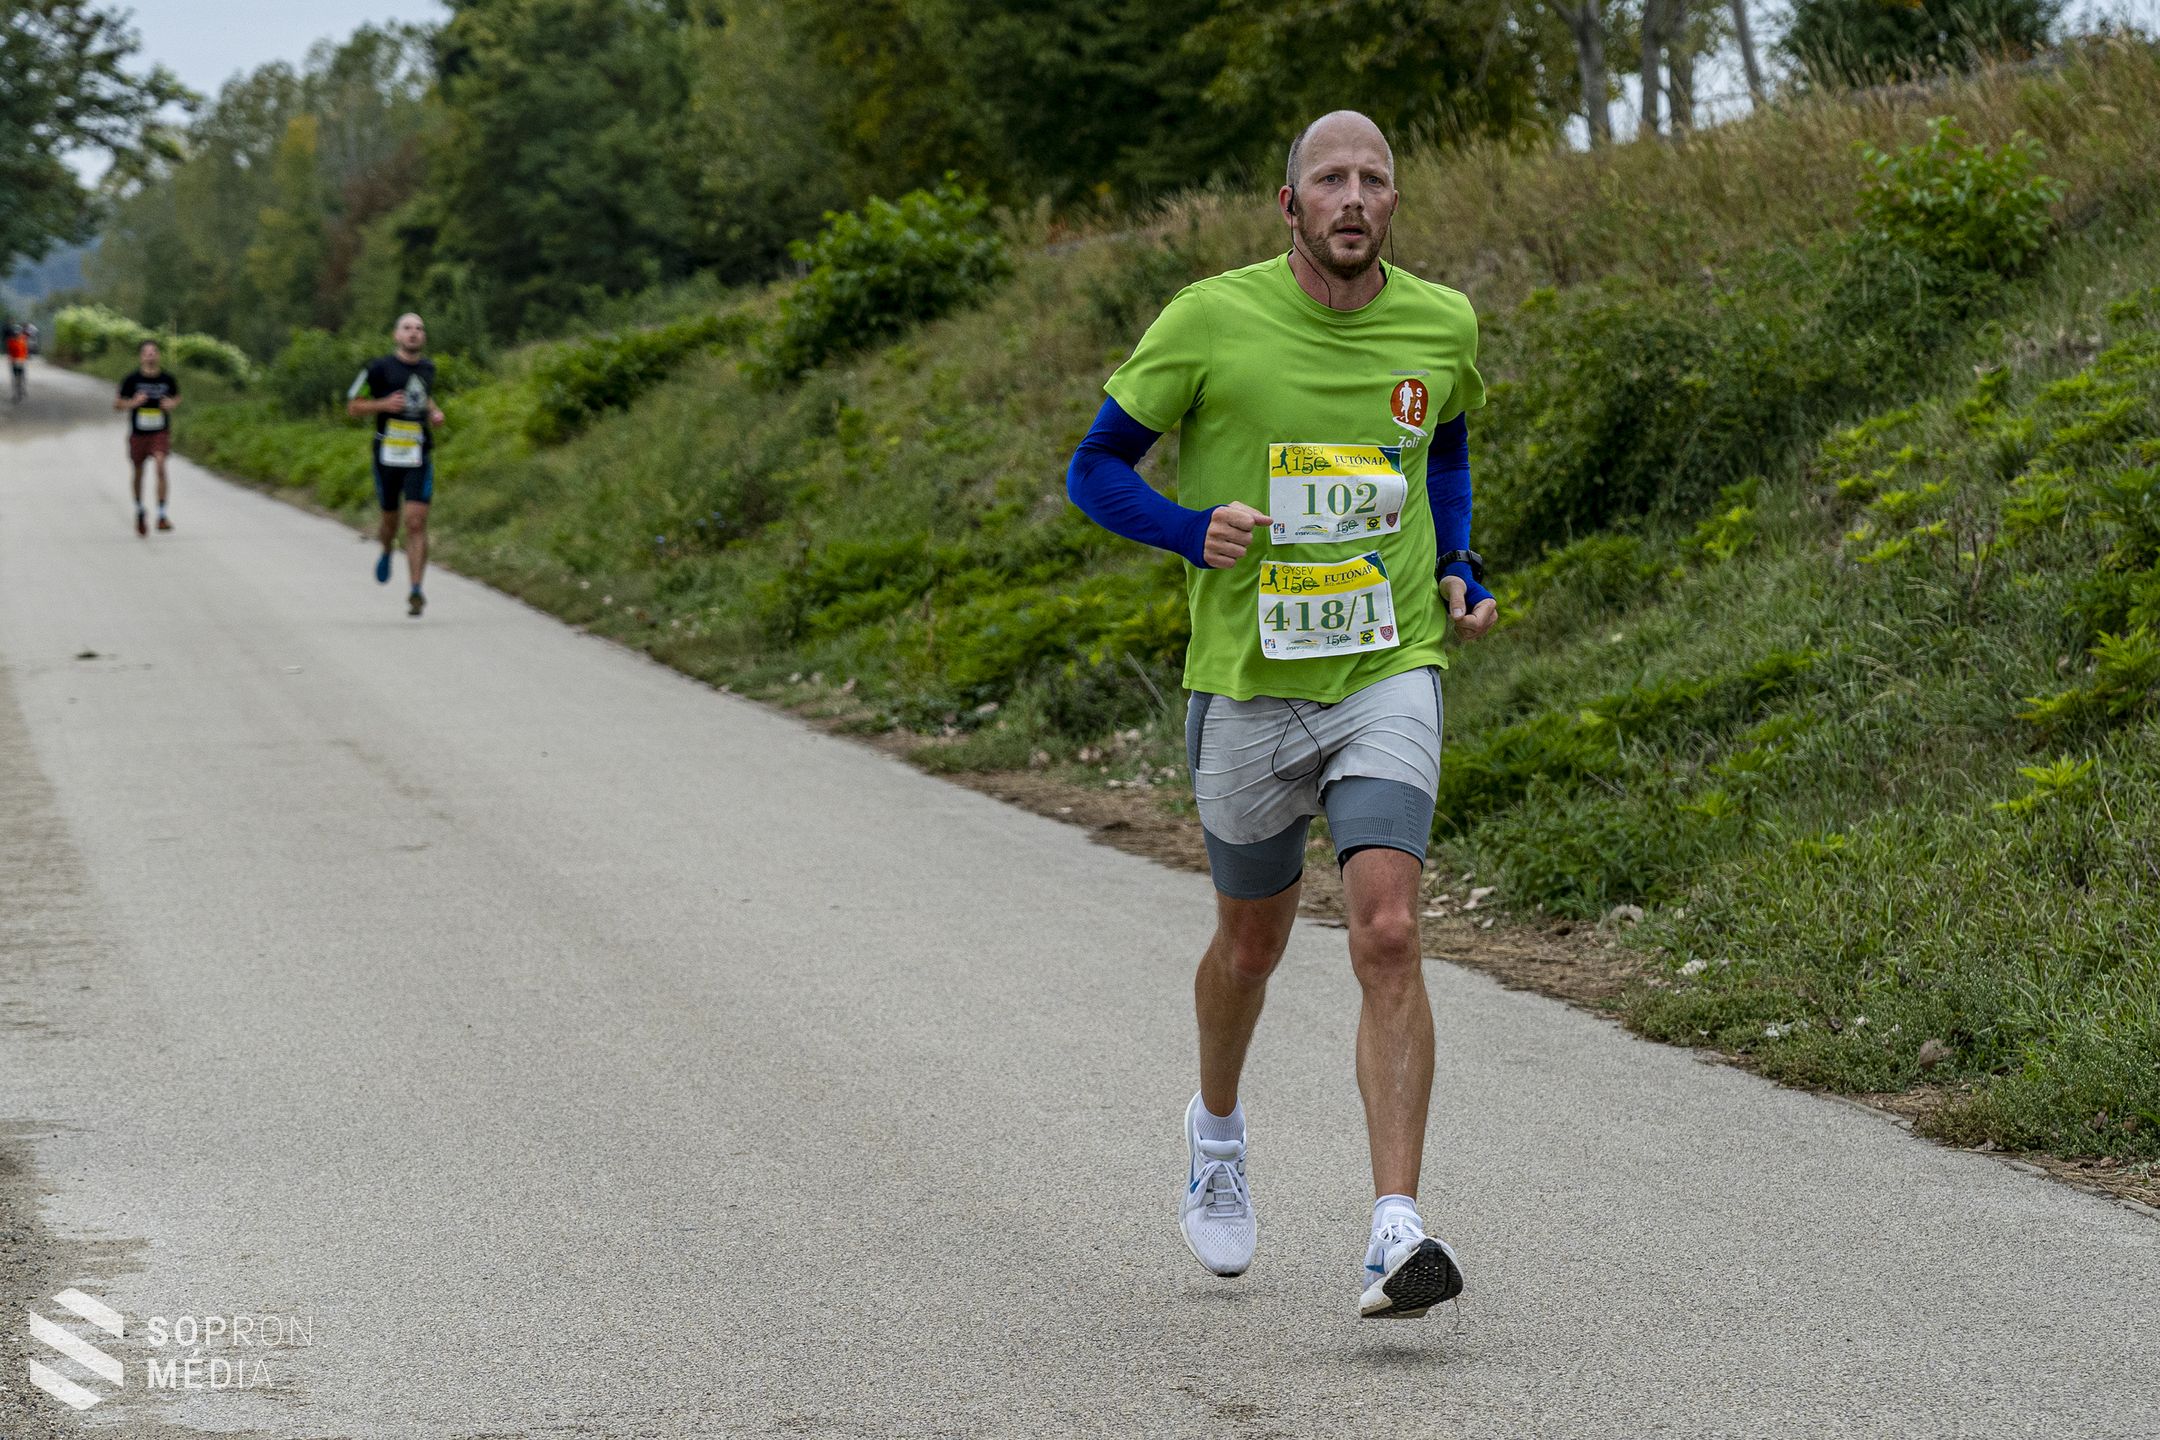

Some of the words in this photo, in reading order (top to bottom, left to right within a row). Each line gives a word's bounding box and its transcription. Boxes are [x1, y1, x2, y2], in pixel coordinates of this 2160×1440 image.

[1398, 436, 1420, 448] Zoli
[1292, 446, 1324, 456] GYSEV
[1334, 453, 1386, 466] FUTÓNAP
[1301, 482, 1378, 516] 102
[1282, 565, 1314, 575] GYSEV
[1324, 564, 1373, 583] FUTÓNAP
[1264, 592, 1380, 632] 418/1
